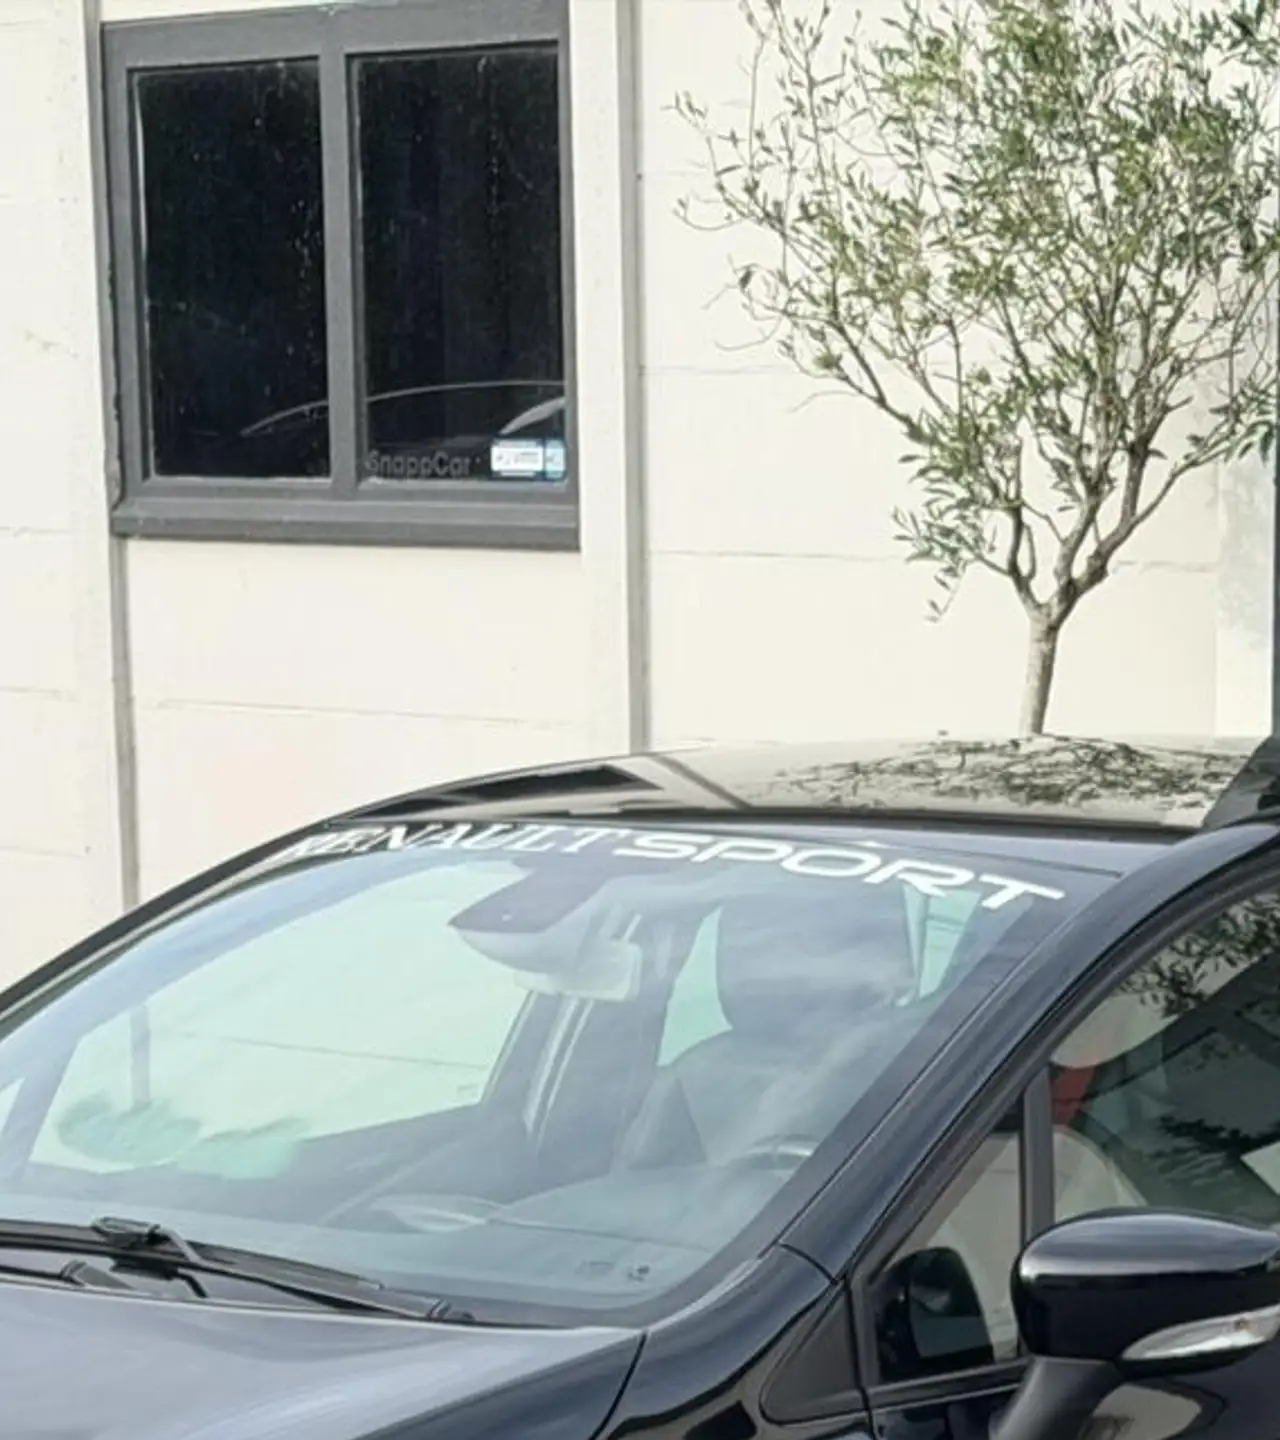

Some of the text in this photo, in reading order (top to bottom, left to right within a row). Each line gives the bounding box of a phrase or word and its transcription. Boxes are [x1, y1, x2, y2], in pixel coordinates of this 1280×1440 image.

[364, 450, 471, 478] SnappCar
[293, 823, 1065, 909] RENAULT SPORT
